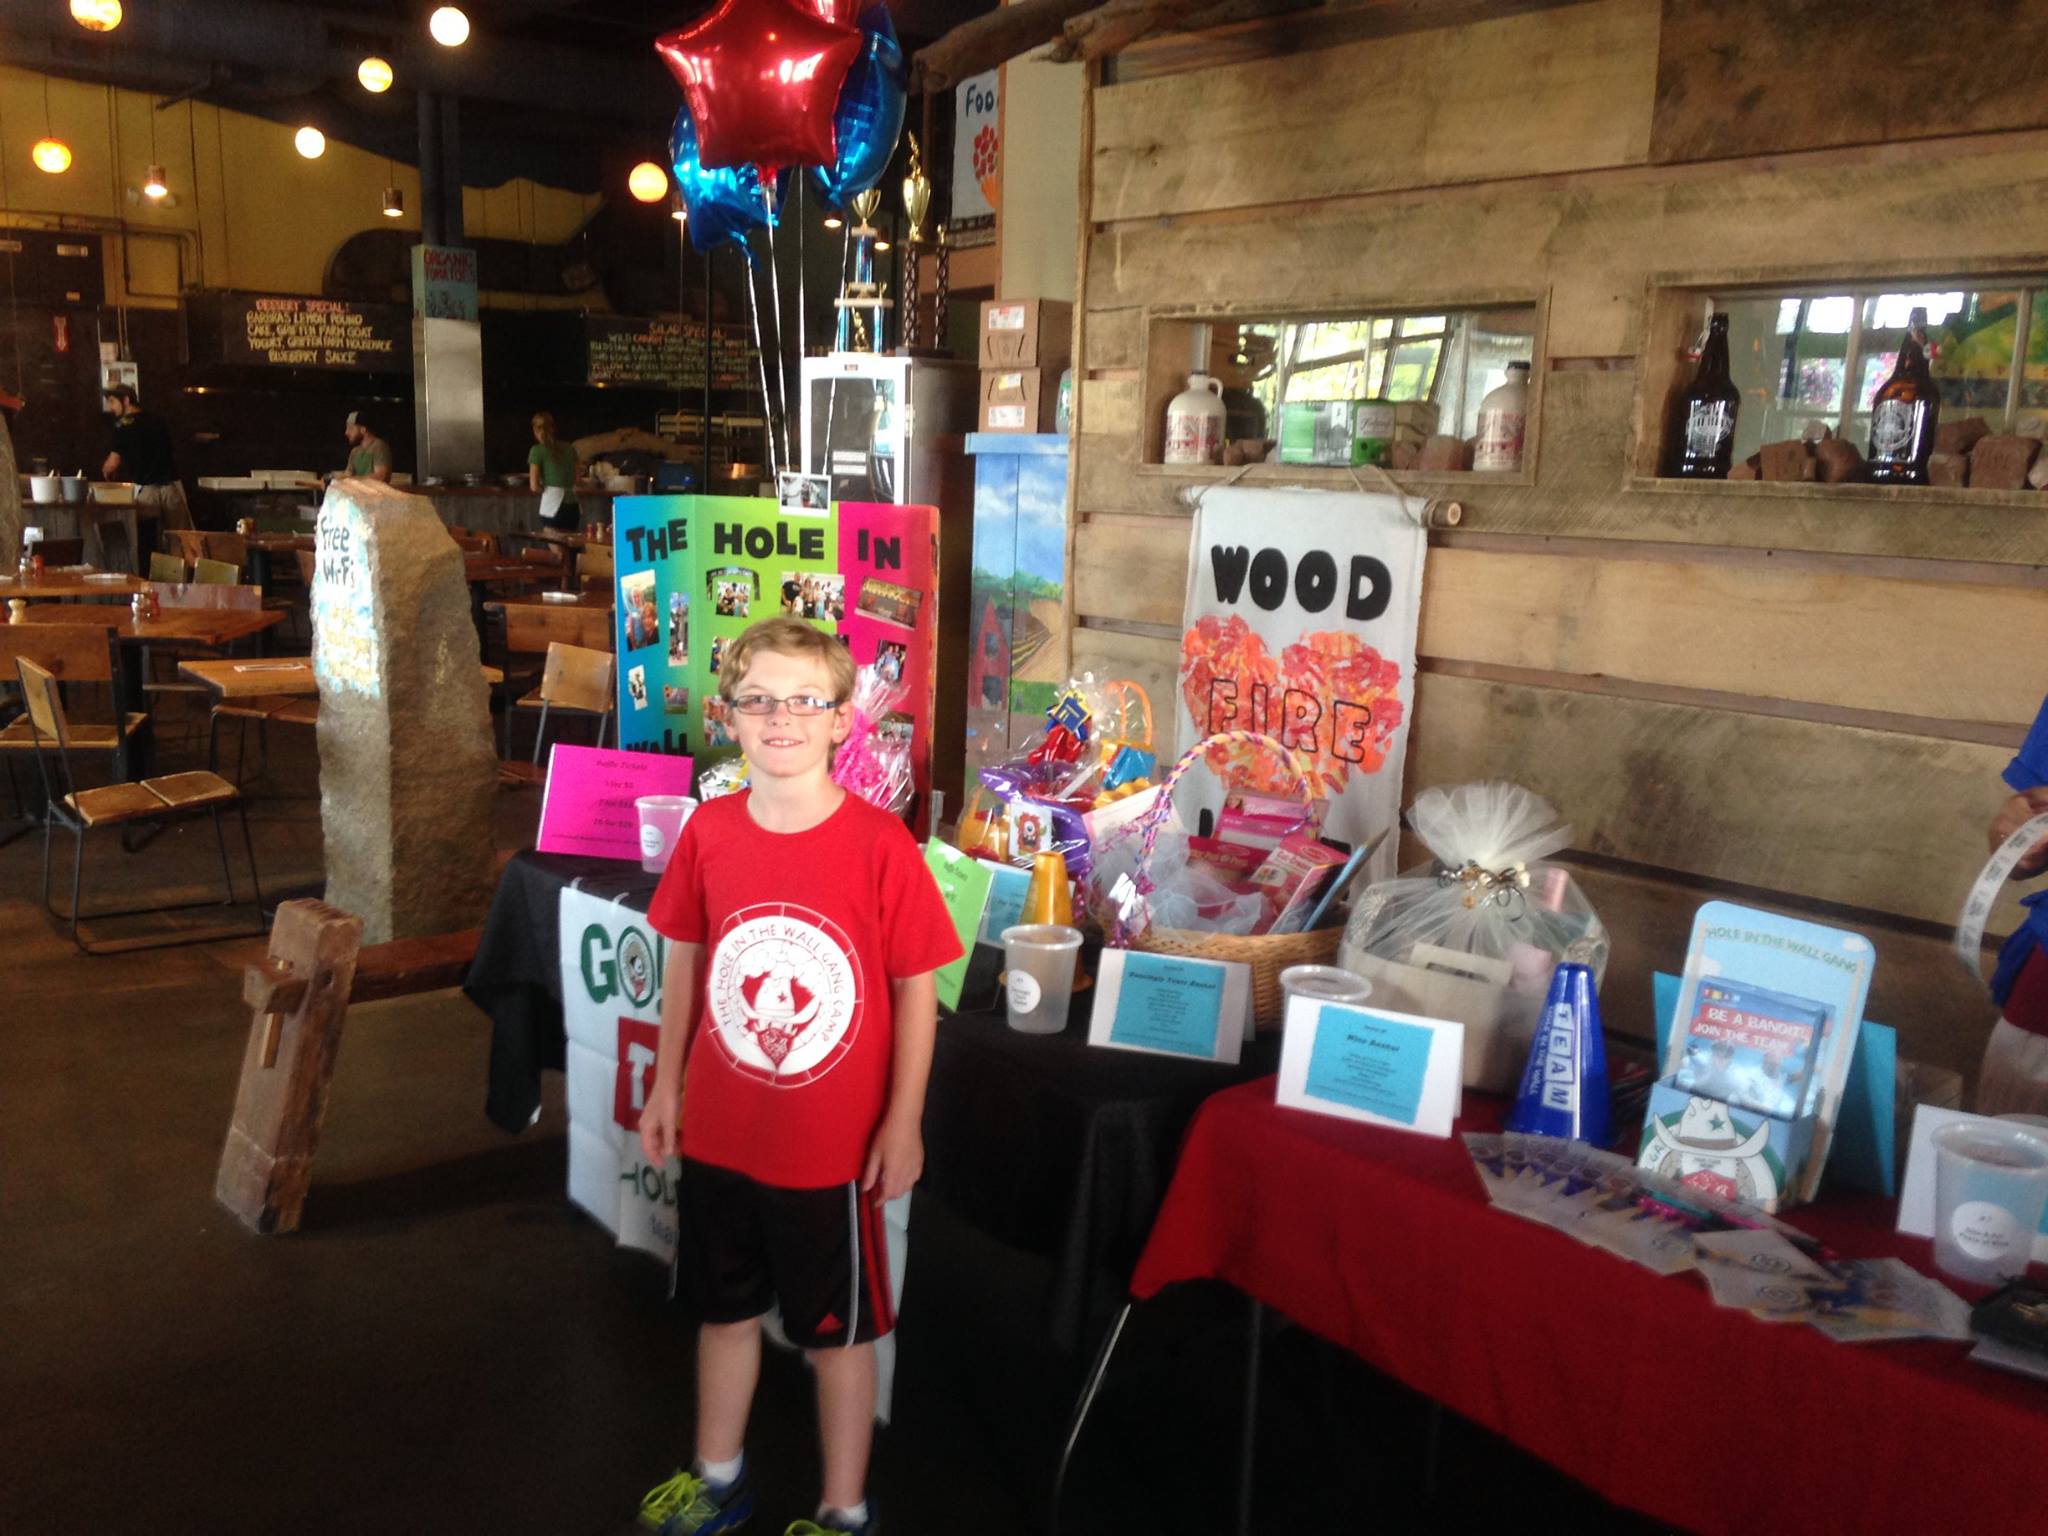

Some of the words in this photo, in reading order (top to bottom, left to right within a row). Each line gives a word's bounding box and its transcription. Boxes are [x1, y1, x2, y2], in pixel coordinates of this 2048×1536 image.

[966, 84, 999, 118] FOO
[256, 299, 299, 311] DESSERT
[320, 516, 350, 552] Free
[626, 518, 688, 562] THE
[714, 522, 825, 559] HOLE
[857, 529, 901, 569] IN
[1211, 544, 1392, 621] WOOD
[1208, 678, 1372, 763] FIRE
[731, 935, 747, 953] IN
[749, 924, 776, 940] THE
[784, 925, 820, 951] WALL
[1706, 927, 1740, 940] HOLE
[1744, 932, 1758, 944] IN
[1760, 934, 1785, 949] THE
[1787, 939, 1820, 960] WALL
[1822, 952, 1857, 974] GANG
[717, 951, 735, 992] HOLE
[822, 952, 844, 994] GANG
[717, 998, 731, 1025] THE
[823, 1000, 844, 1042] CAMP
[1709, 1007, 1728, 1021] BE
[1733, 1013, 1744, 1026] A
[1695, 1023, 1721, 1036] JOIN
[1726, 1029, 1749, 1043] THE
[1754, 1034, 1792, 1052] TEAM
[1548, 1007, 1571, 1107] TEAM
[620, 1162, 677, 1205] HOL
